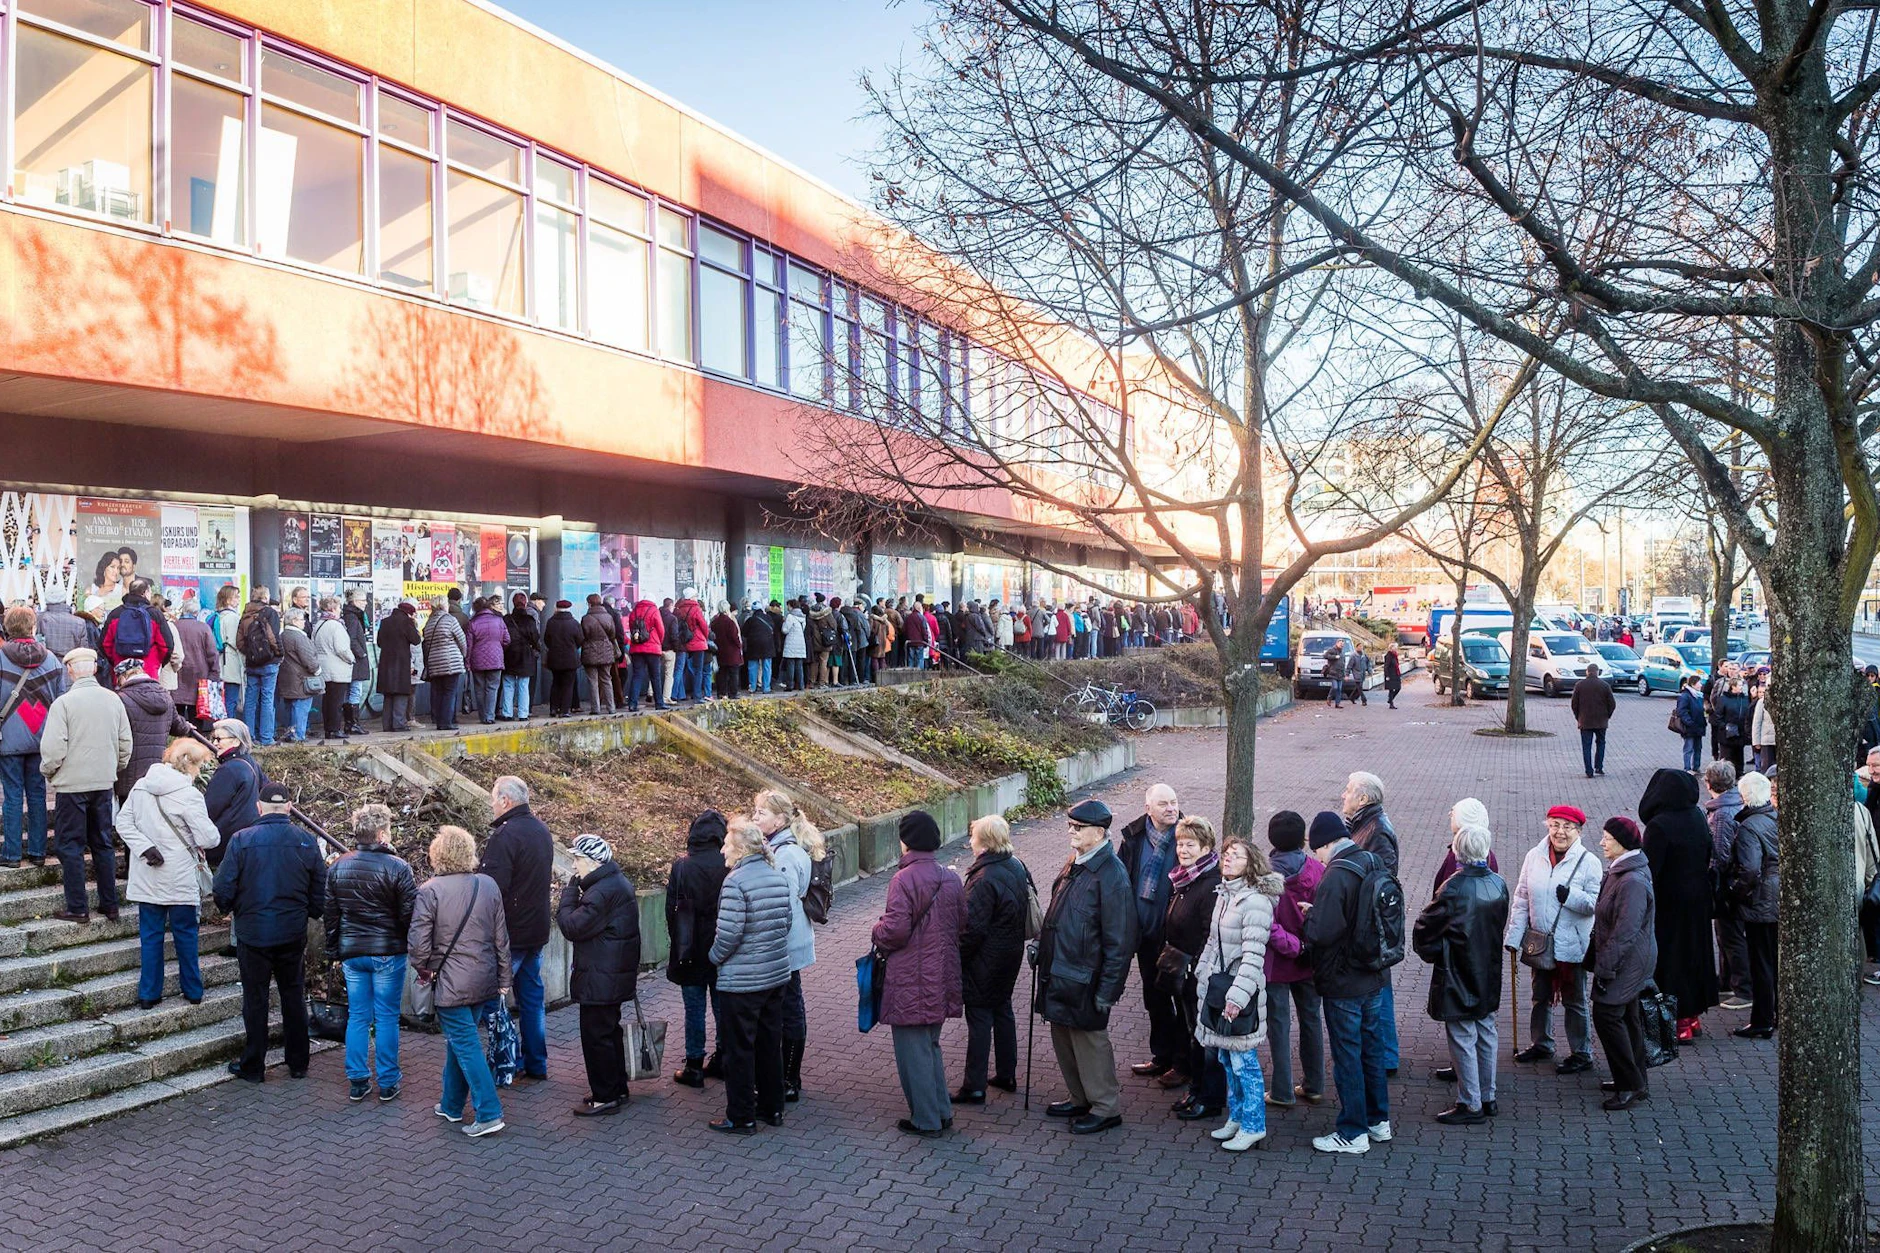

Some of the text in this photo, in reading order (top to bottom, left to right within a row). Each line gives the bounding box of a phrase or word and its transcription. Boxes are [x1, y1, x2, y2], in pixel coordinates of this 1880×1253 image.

[92, 516, 112, 526] ANNA
[85, 525, 119, 536] NETREBKO
[161, 526, 198, 537] ISKURS UND
